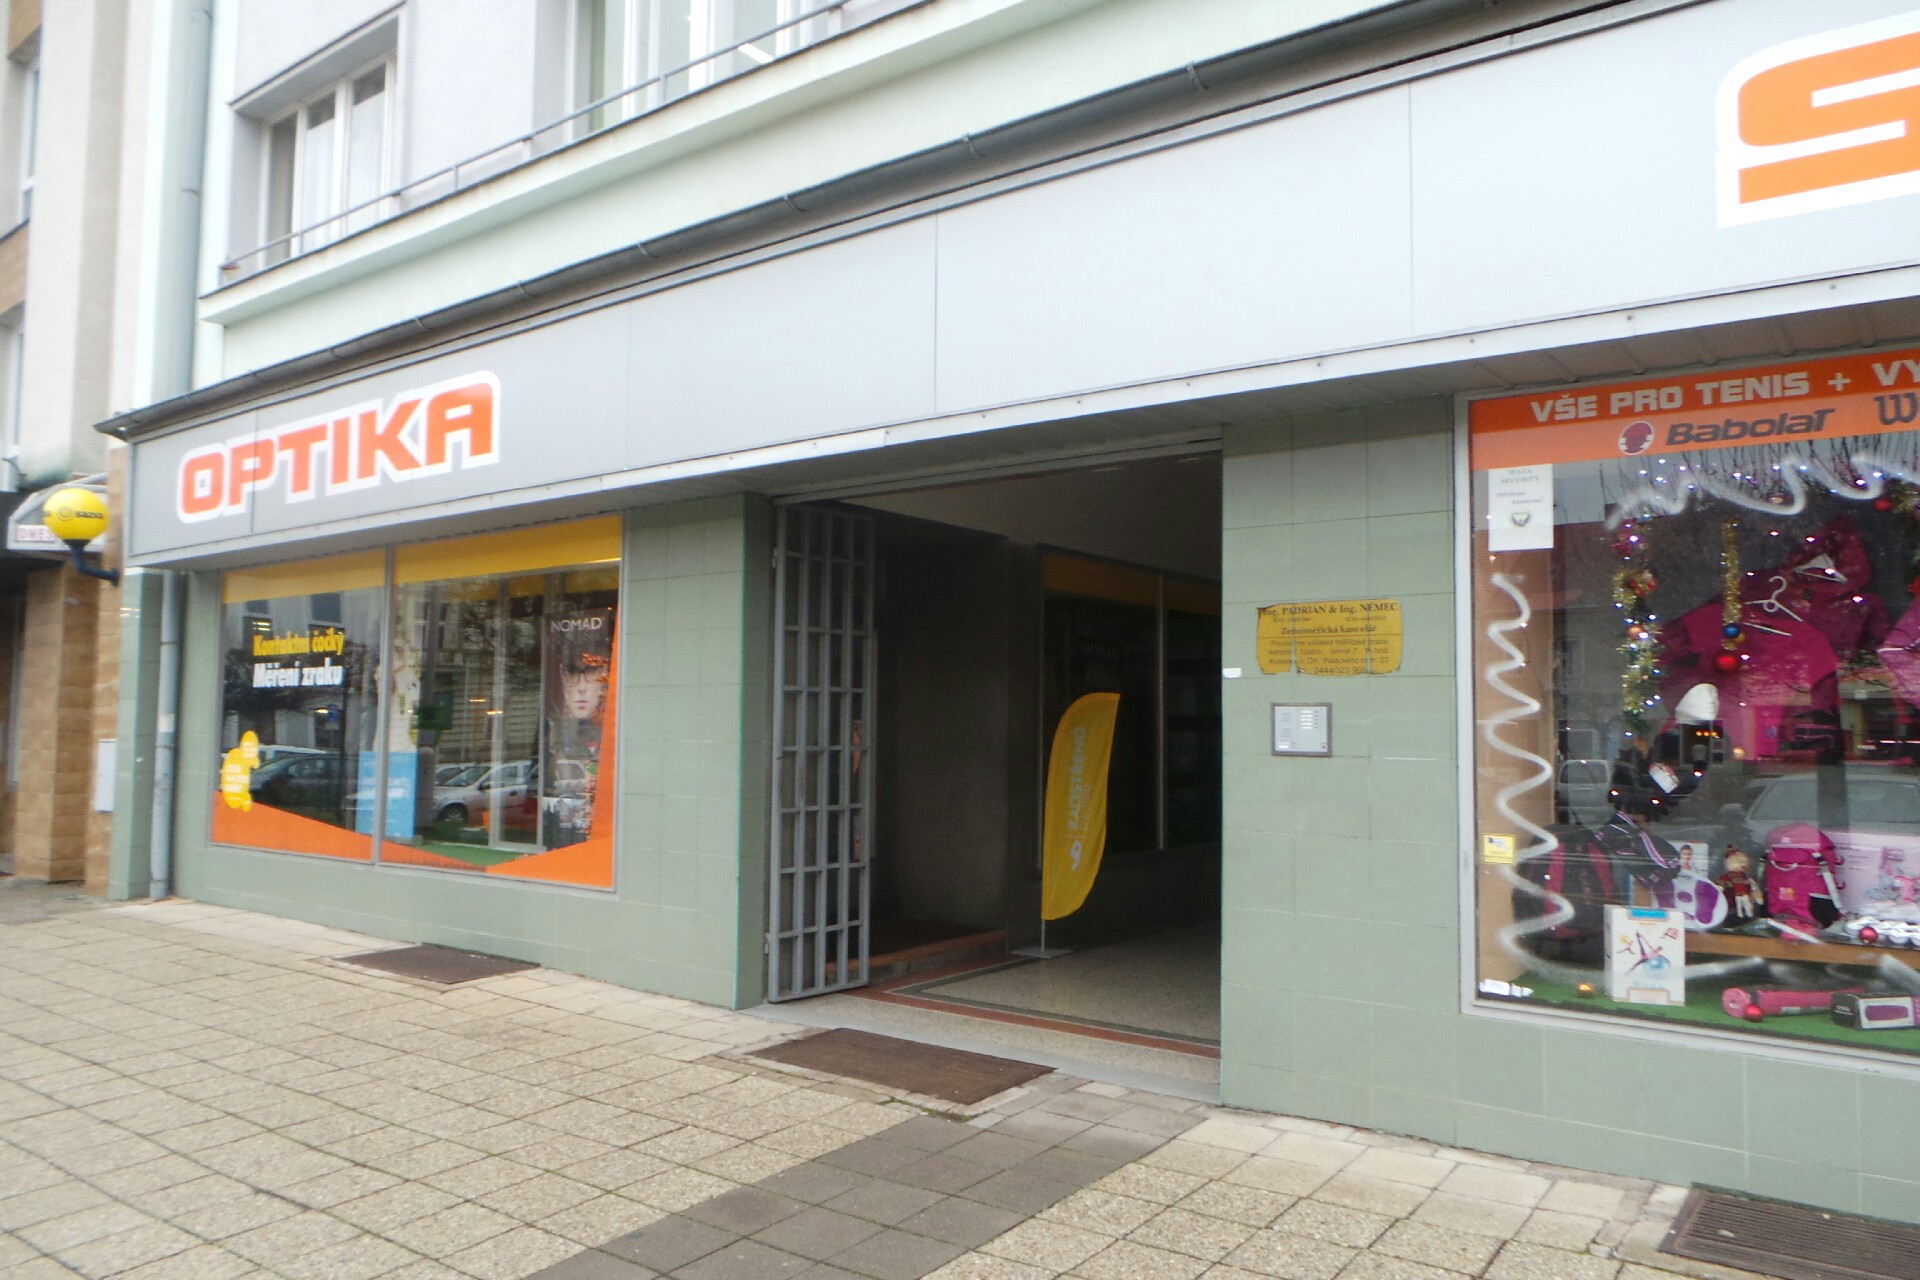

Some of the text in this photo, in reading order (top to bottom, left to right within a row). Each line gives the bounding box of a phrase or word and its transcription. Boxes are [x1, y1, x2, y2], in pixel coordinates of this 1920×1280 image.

[1531, 394, 1597, 423] VŠE
[1610, 386, 1683, 414] PRO
[1695, 372, 1809, 406] TENIS
[1828, 372, 1851, 391] +
[180, 379, 496, 518] OPTIKA
[1329, 604, 1337, 613] &
[1340, 604, 1358, 614] Ing.
[551, 617, 602, 632] NOMAD
[311, 627, 345, 656] čočky
[253, 657, 343, 688] Měření zraku
